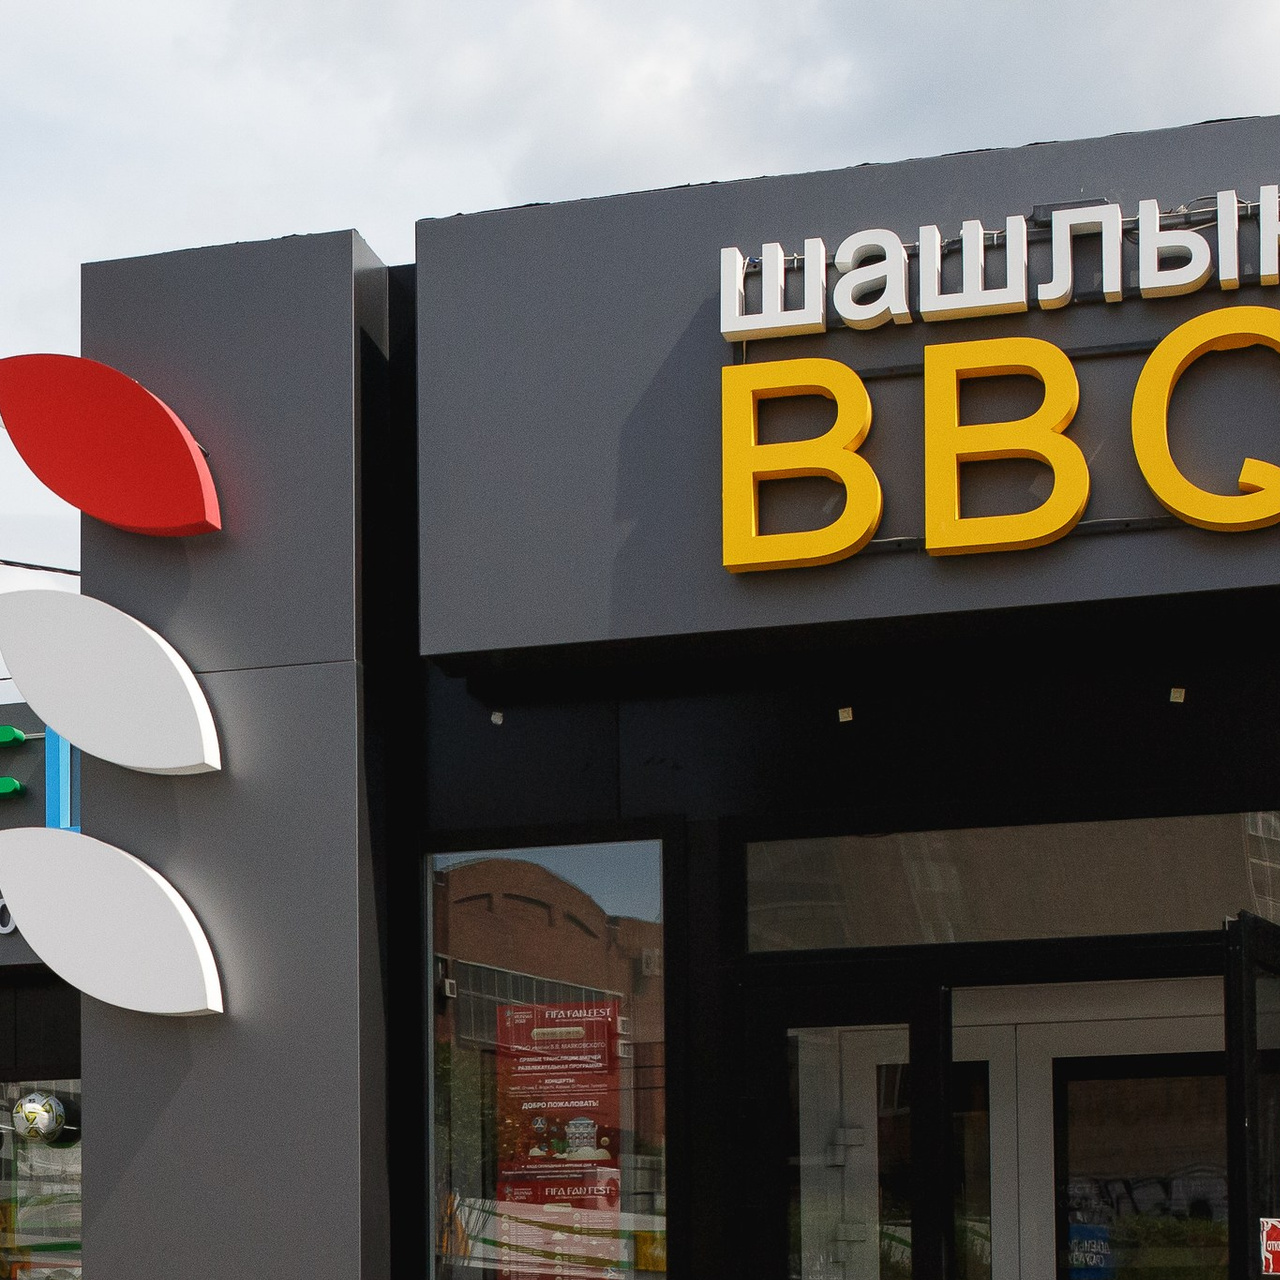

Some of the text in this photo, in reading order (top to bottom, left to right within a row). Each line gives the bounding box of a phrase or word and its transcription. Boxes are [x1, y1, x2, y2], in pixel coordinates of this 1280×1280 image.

[722, 306, 1280, 574] BBQ
[545, 1010, 566, 1019] FIFA
[545, 1188, 565, 1196] FIFA
[567, 1187, 586, 1195] FAN
